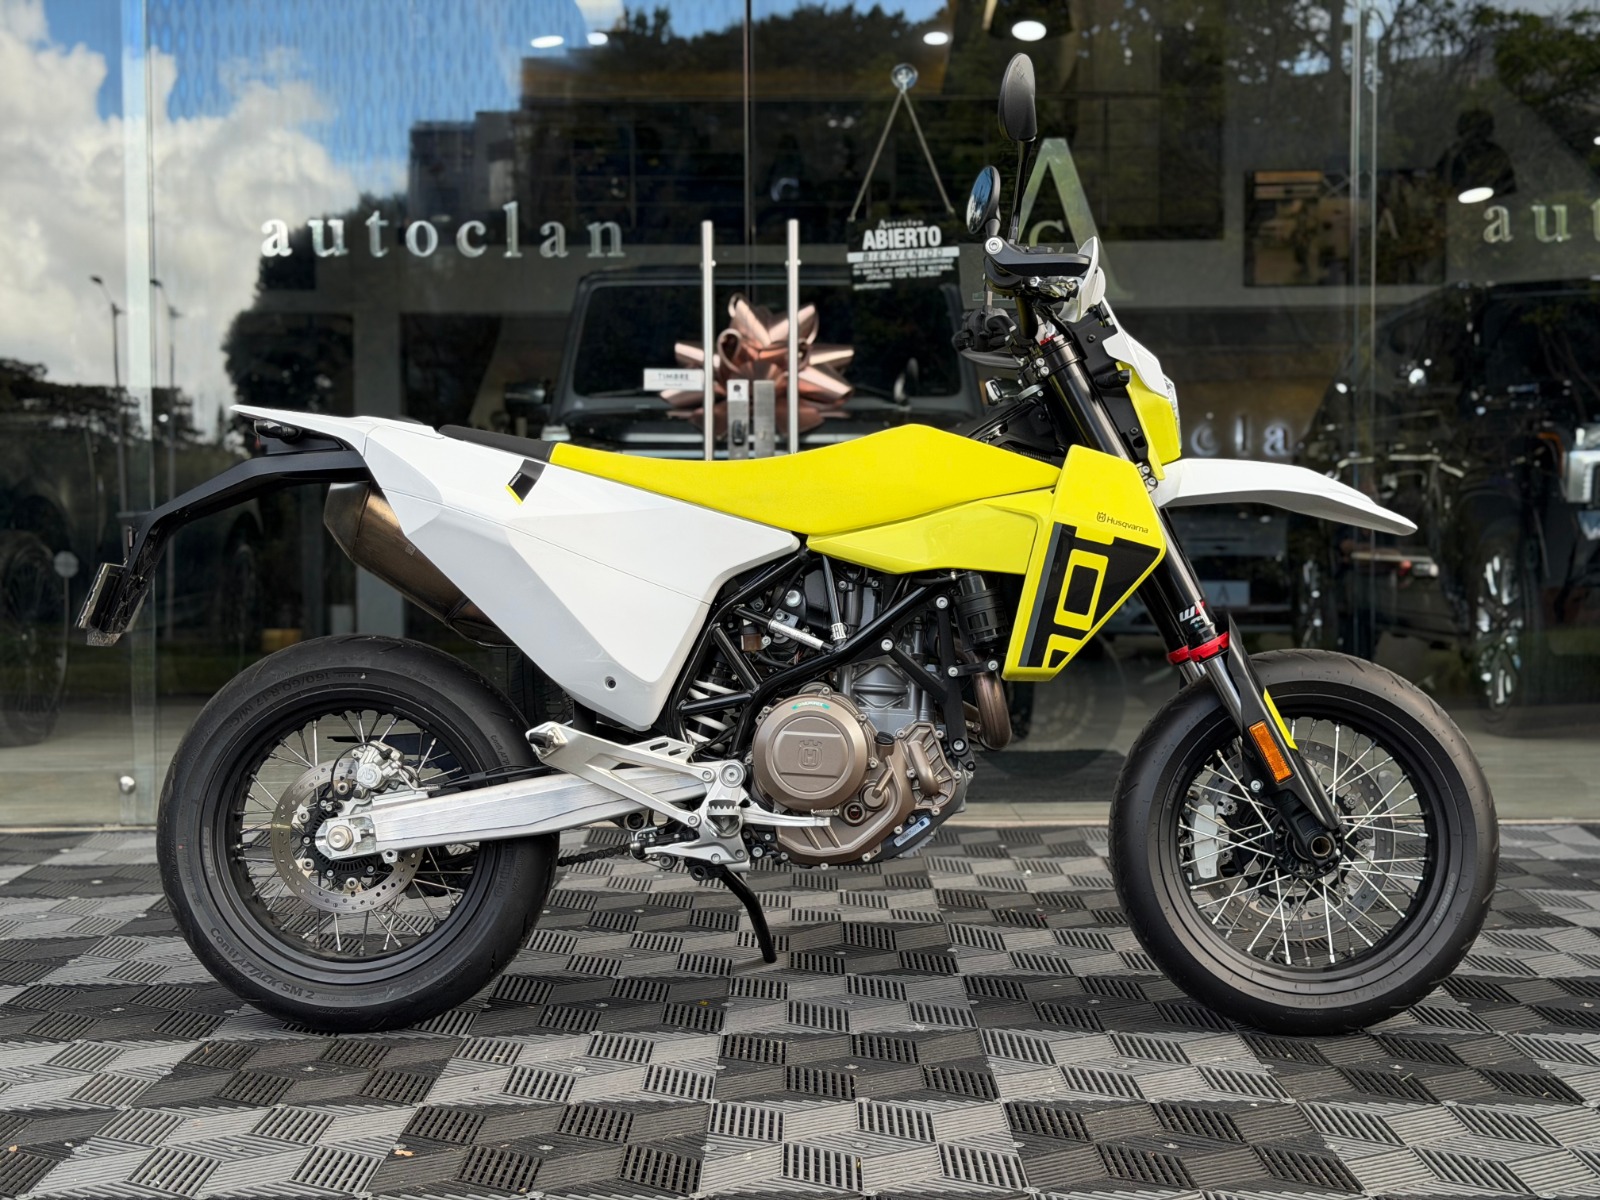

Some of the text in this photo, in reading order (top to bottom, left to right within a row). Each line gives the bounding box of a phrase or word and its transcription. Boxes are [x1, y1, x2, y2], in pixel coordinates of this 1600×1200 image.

[261, 201, 625, 257] autoclan
[862, 226, 942, 251] ABIERTO
[863, 248, 943, 262] BIENVENIDO
[658, 373, 689, 381] TIMBRE
[1106, 515, 1149, 534] Husqvarna
[203, 827, 215, 879] TUBELESS
